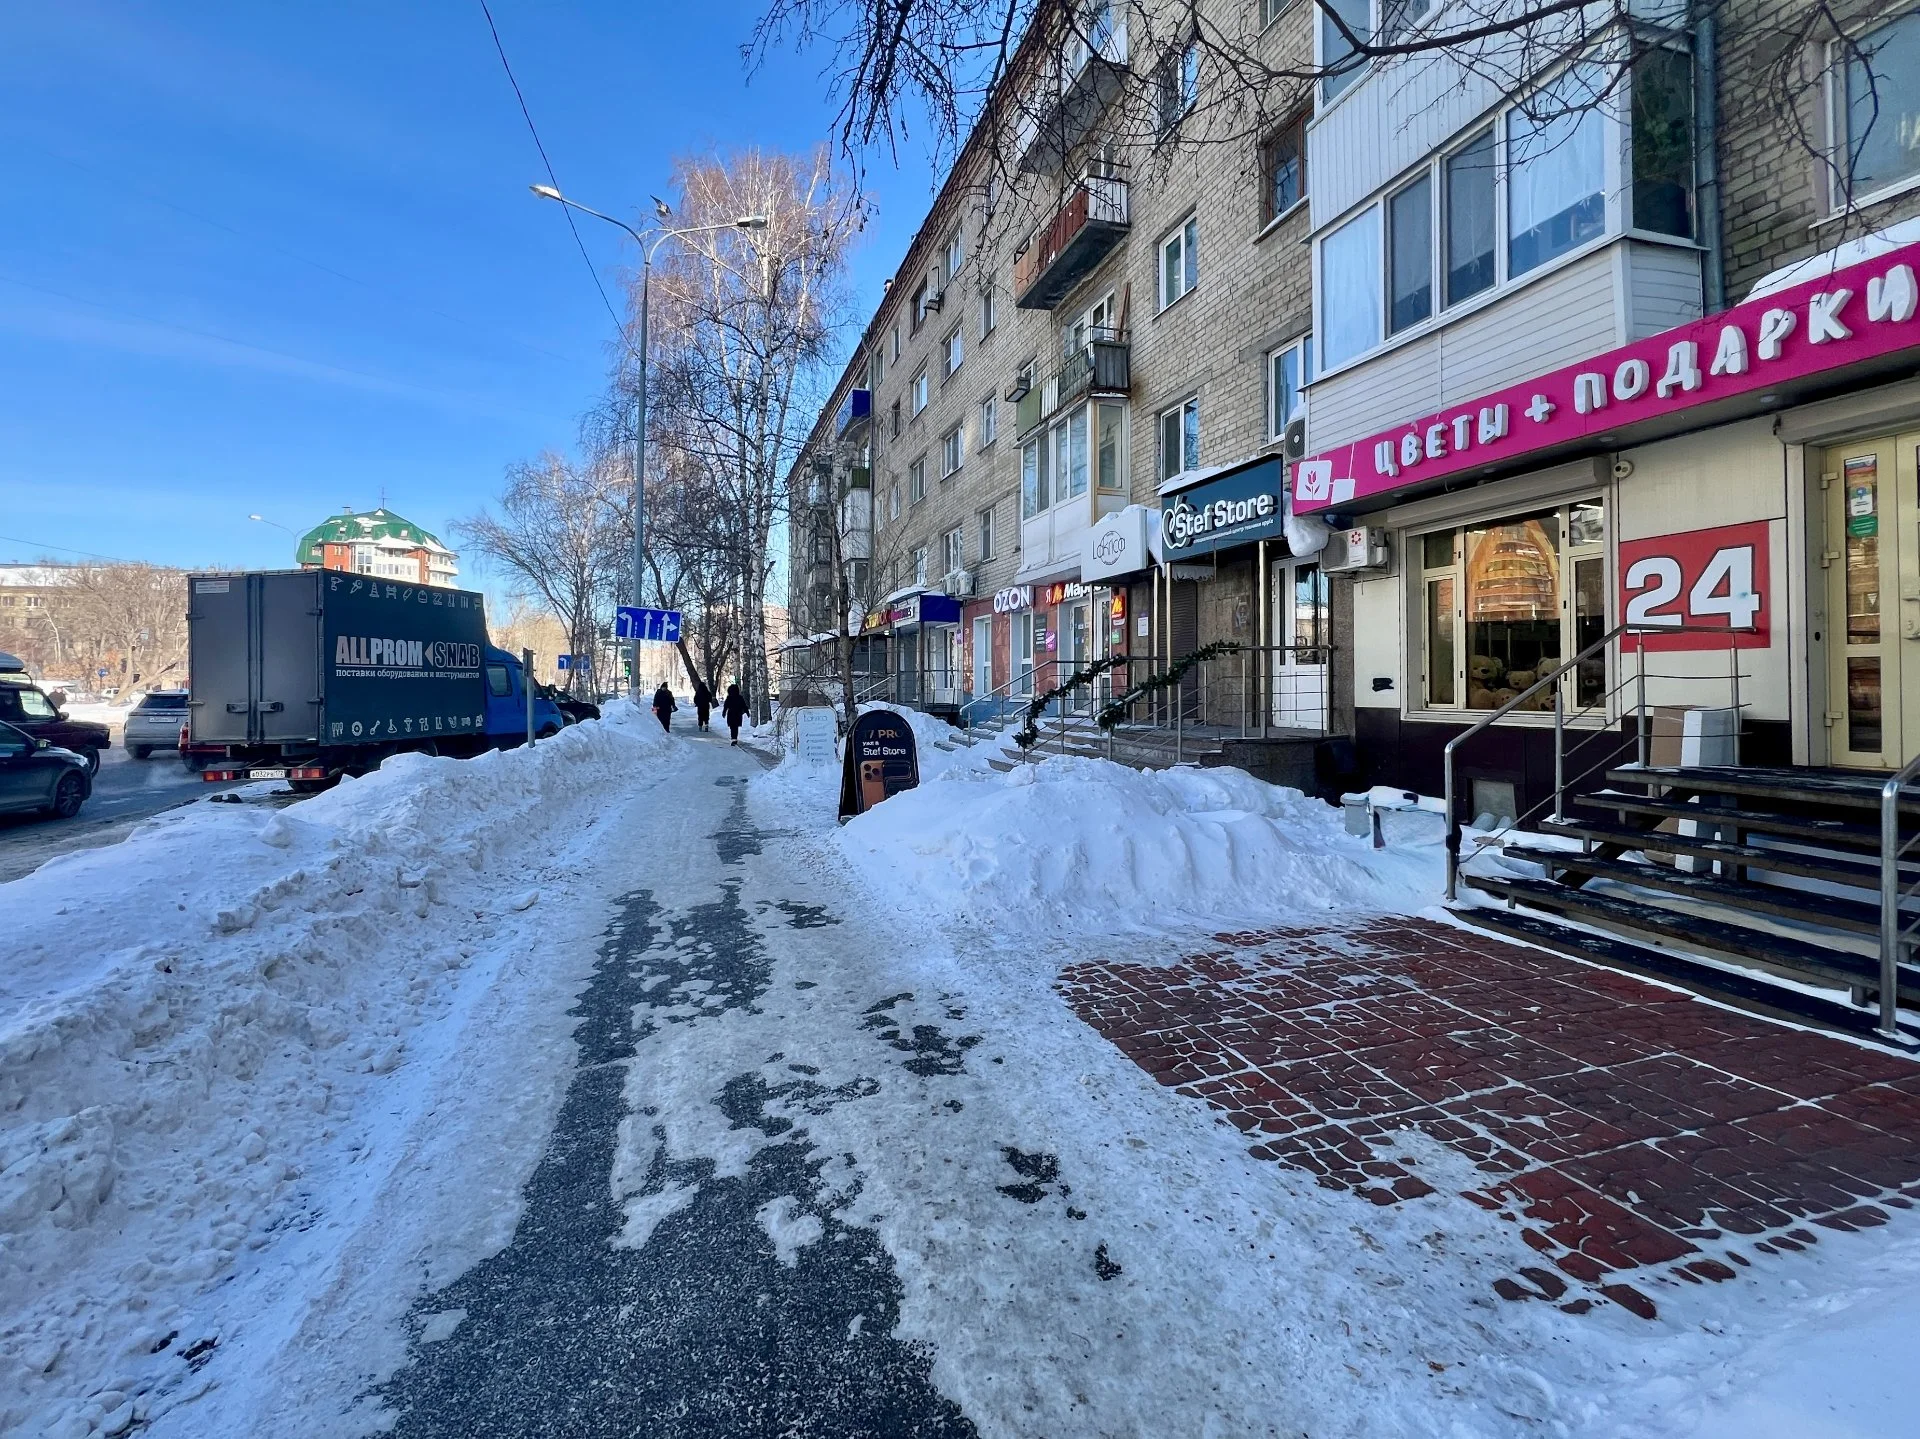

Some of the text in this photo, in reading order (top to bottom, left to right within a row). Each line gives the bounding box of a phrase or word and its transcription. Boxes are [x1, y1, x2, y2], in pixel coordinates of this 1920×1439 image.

[1375, 403, 1508, 477] ЦВЕТЫ
[1574, 264, 1918, 414] ПОДАРКИ
[1175, 494, 1273, 539] Stef Store
[993, 585, 1031, 614] OZON
[1625, 544, 1761, 634] 24
[335, 635, 480, 669] ALLPROM SNAB
[335, 669, 376, 678] поставки
[377, 668, 429, 680] оборудования
[435, 671, 480, 680] инструментов
[878, 729, 905, 739] PRO
[863, 746, 906, 756] Stef Store
